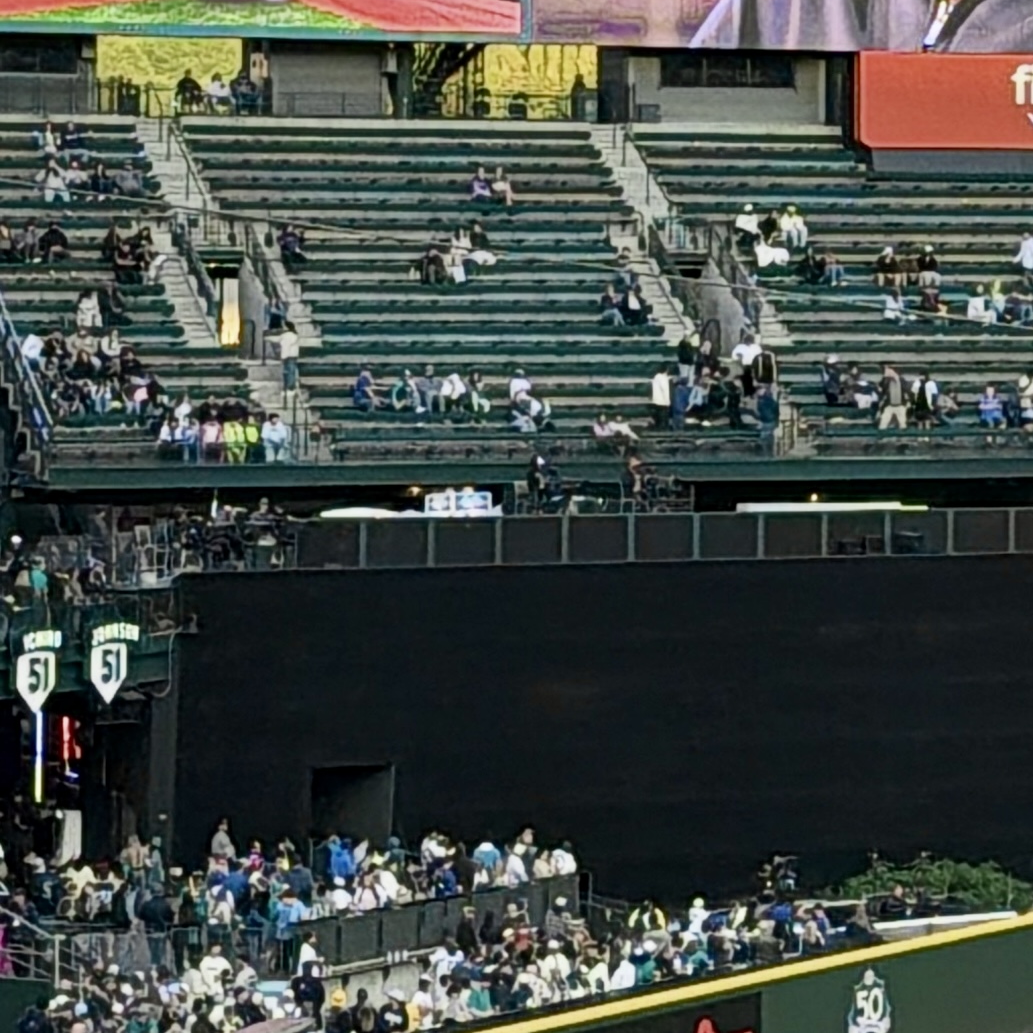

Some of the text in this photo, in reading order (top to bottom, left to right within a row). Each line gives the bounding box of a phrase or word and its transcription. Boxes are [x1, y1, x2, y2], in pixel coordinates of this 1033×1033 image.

[28, 657, 49, 694] 51
[101, 647, 121, 684] 51
[856, 987, 884, 1021] 50
